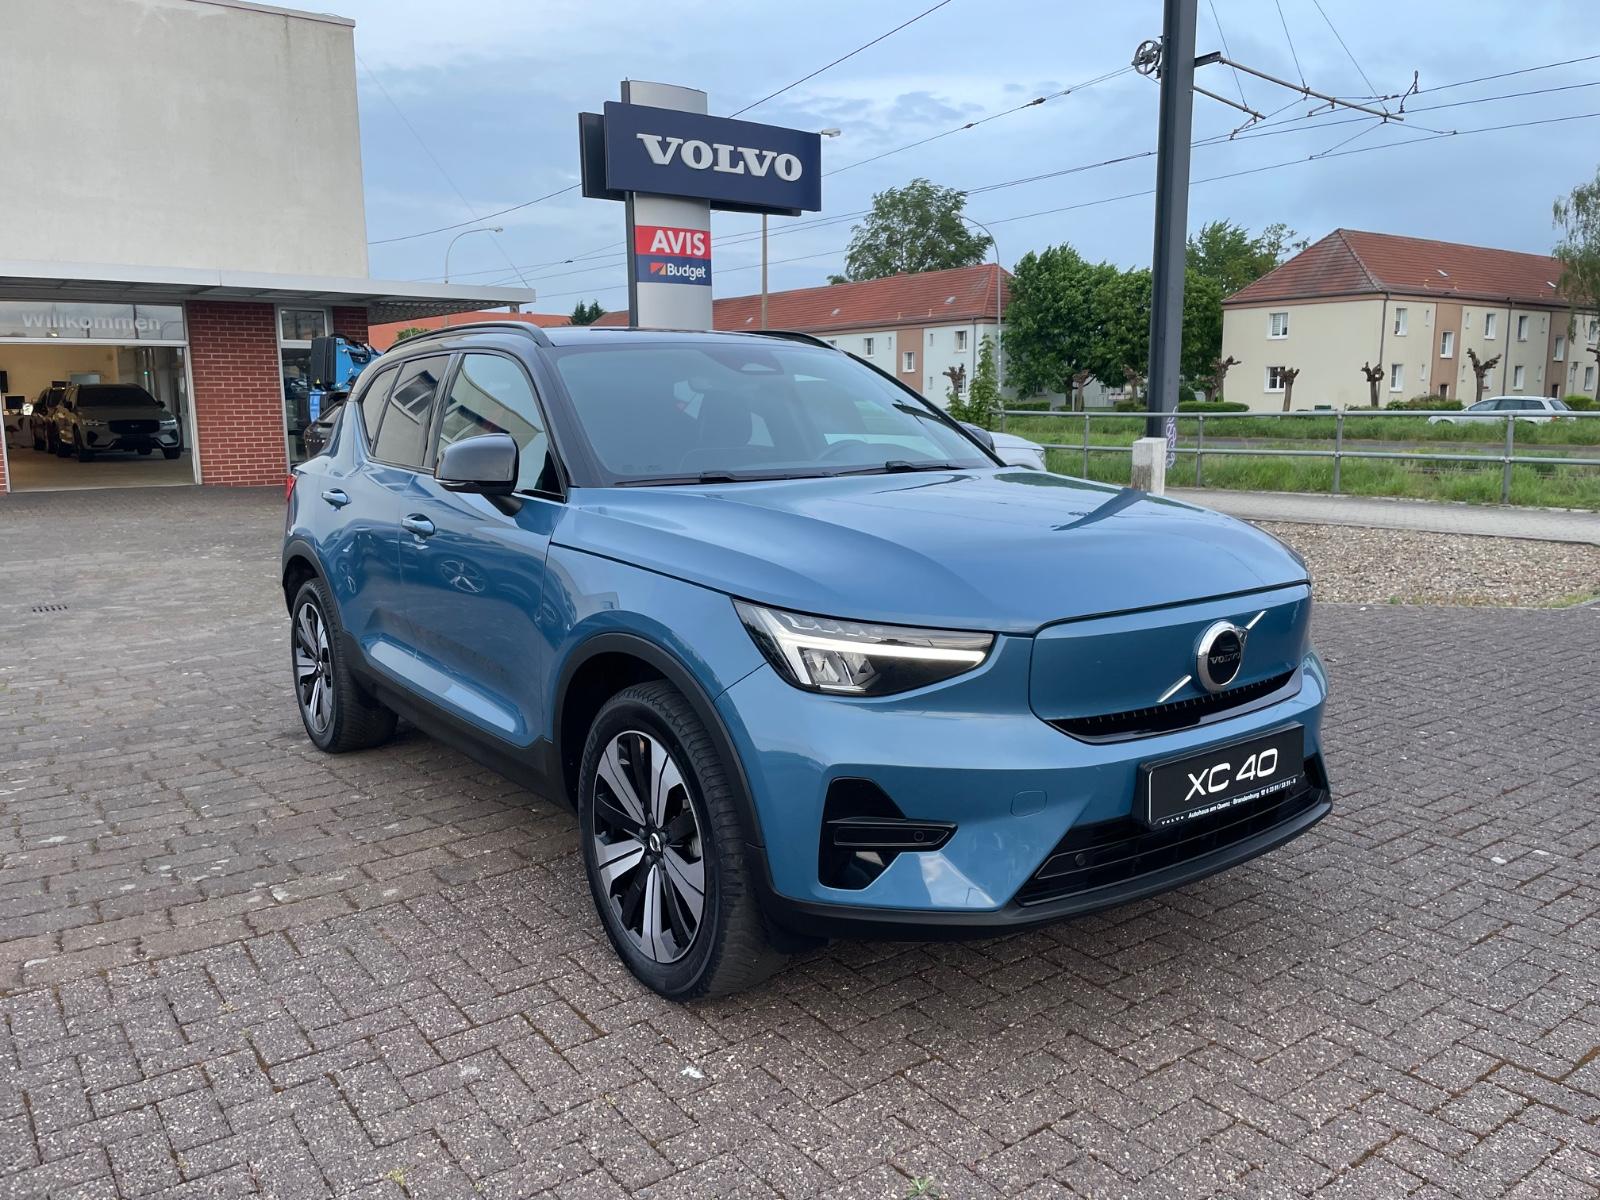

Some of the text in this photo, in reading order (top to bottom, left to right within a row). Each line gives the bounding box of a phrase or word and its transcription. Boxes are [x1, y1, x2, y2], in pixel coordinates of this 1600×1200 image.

[636, 133, 803, 182] VOLVO
[649, 229, 706, 256] AVIS
[667, 263, 706, 281] Budget
[22, 312, 161, 331] Willkommen
[1184, 762, 1231, 801] XC
[1236, 748, 1278, 781] 40
